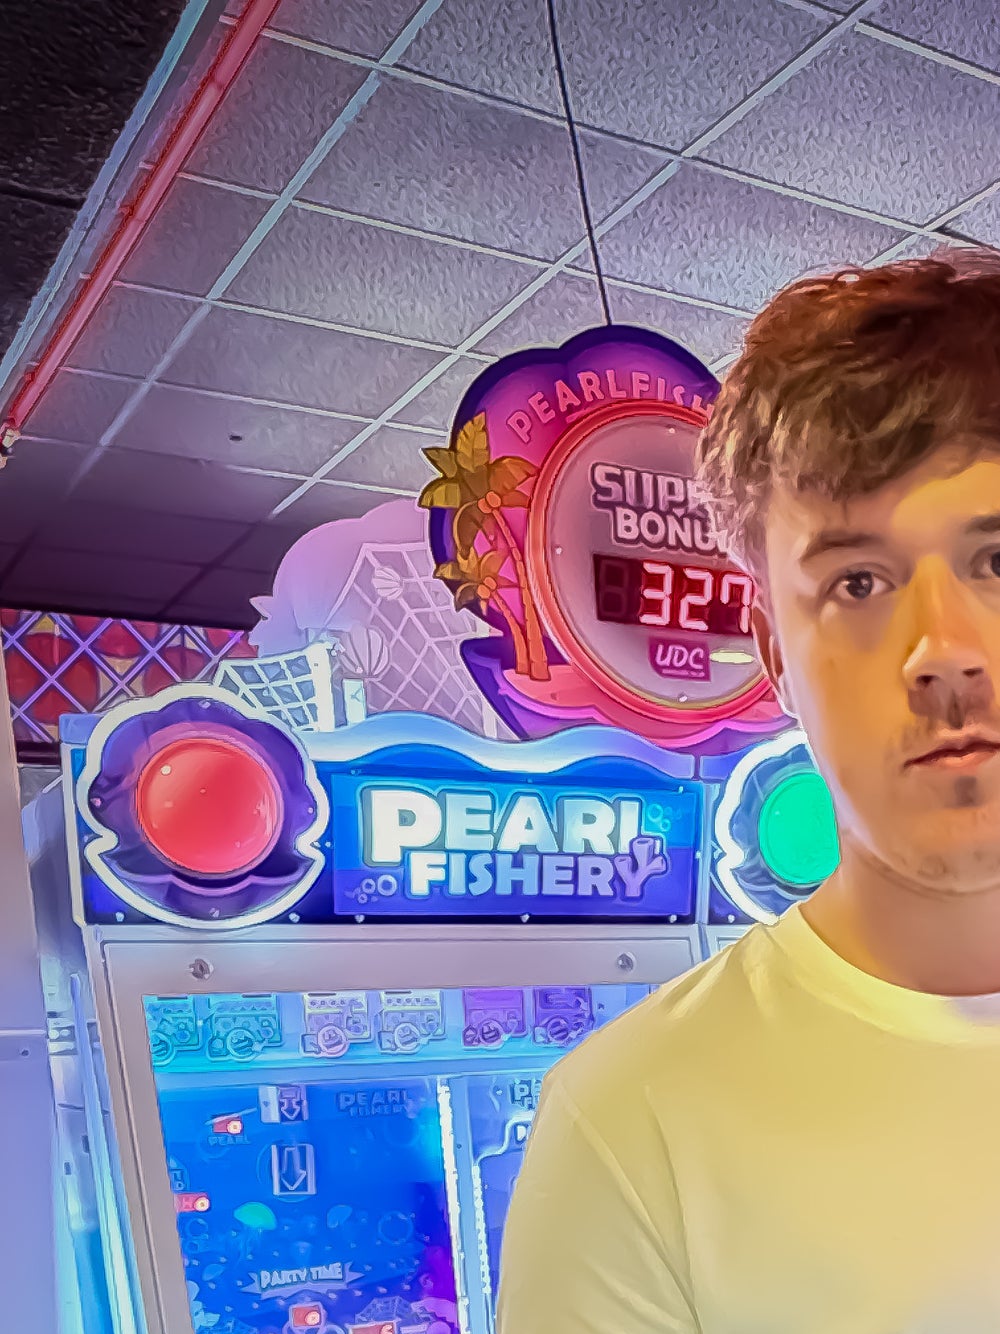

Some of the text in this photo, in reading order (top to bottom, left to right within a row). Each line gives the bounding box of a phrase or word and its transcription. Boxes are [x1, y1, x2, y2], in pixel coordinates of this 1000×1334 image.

[507, 370, 715, 443] PEARLFISH
[594, 464, 712, 512] SUPE
[615, 507, 720, 551] BONU
[638, 561, 754, 634] 327
[655, 644, 704, 669] UDC
[410, 842, 667, 898] FISHERY
